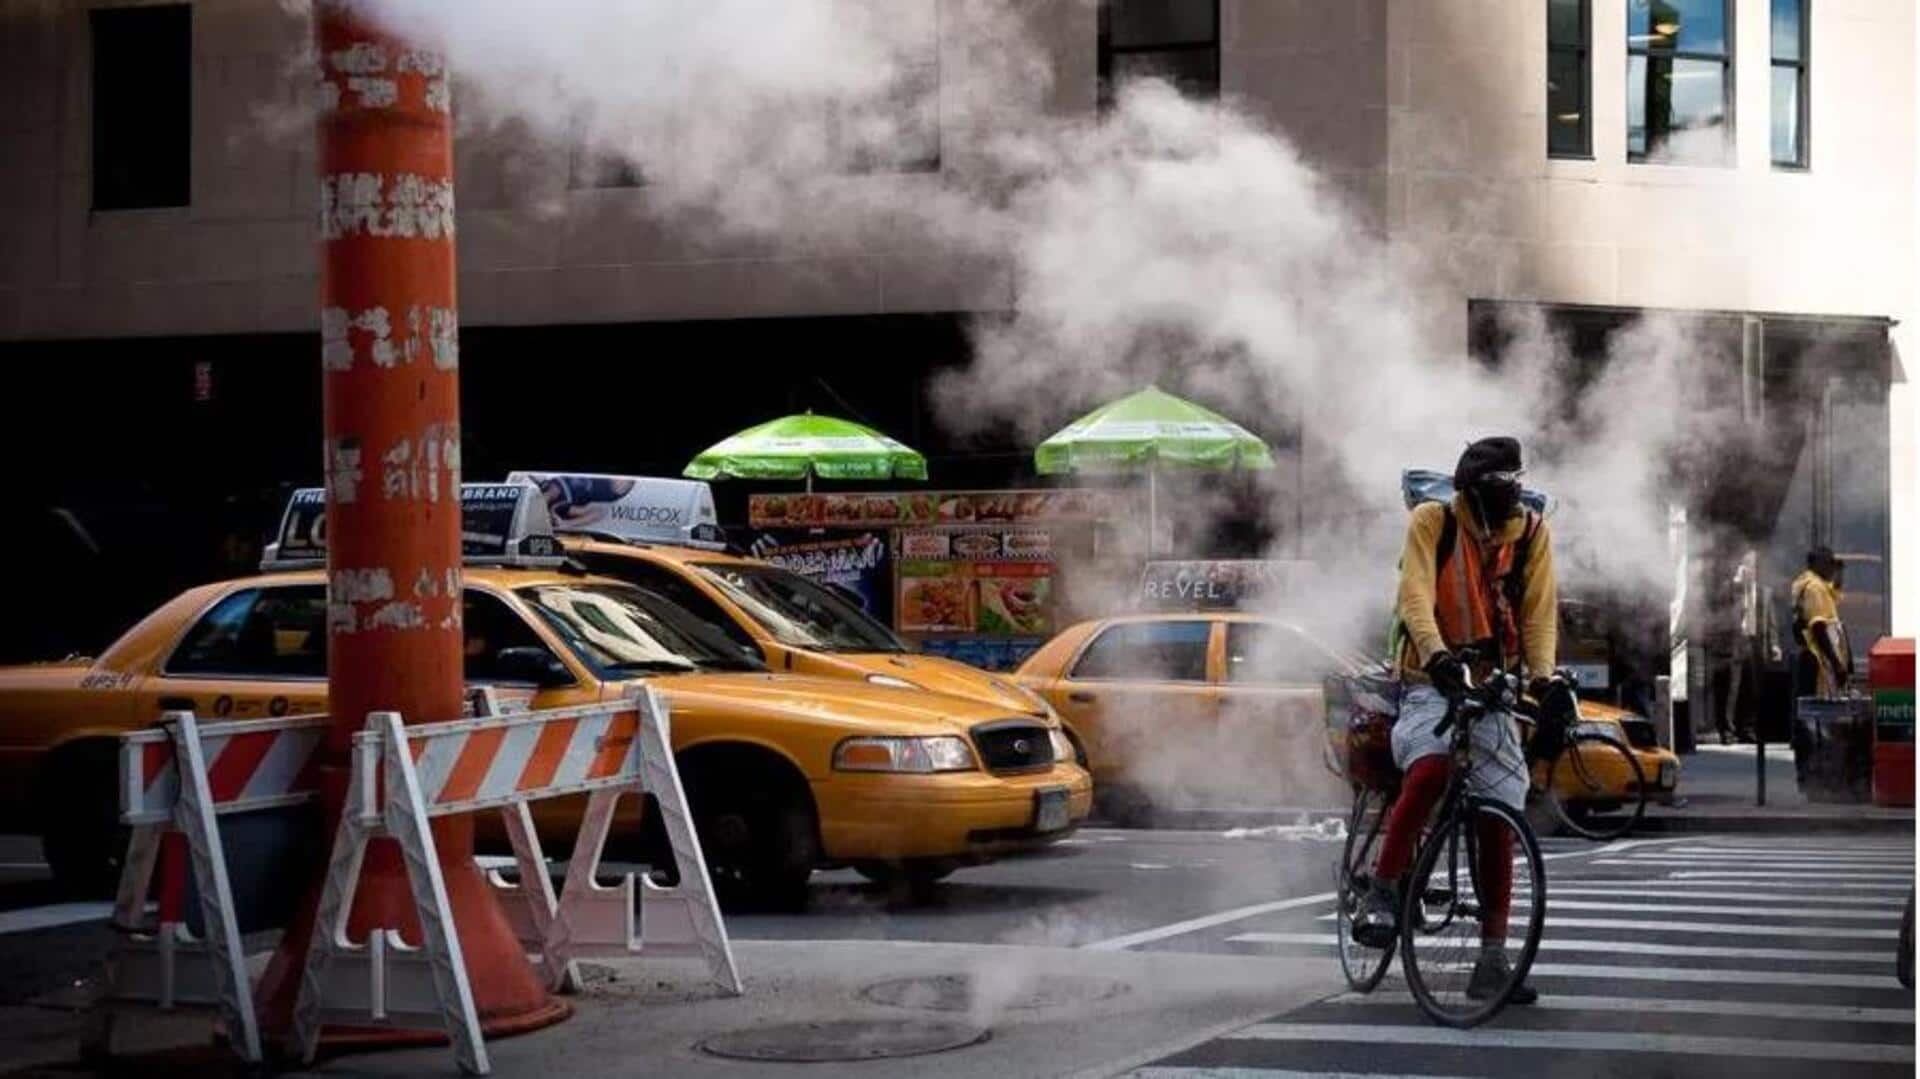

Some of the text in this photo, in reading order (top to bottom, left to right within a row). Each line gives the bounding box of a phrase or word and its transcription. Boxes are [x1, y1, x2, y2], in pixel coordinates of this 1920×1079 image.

[462, 488, 520, 499] BRAND
[610, 505, 681, 523] WILDFOX
[1144, 580, 1220, 598] REVEL
